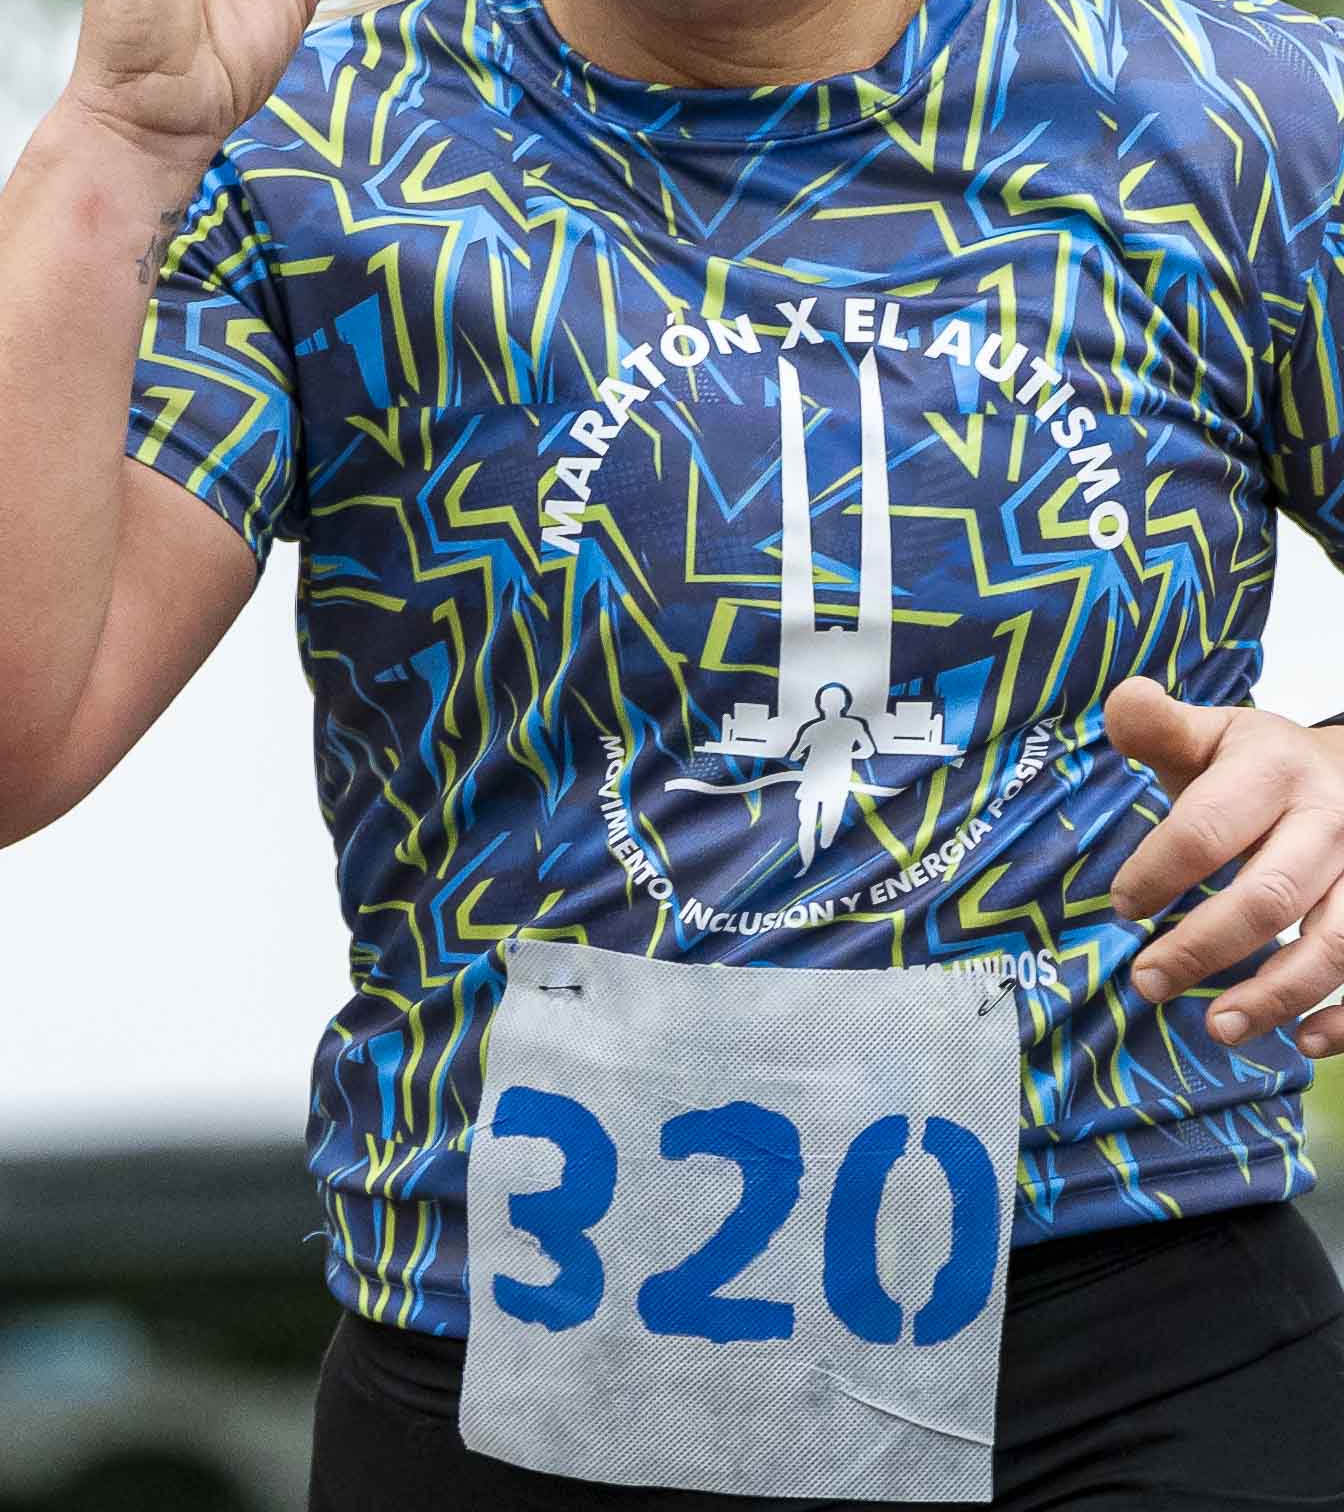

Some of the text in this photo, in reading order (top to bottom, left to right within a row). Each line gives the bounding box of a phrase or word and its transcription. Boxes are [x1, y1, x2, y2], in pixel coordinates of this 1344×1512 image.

[541, 297, 1129, 555] MARATÓN X EL AUTISMO
[839, 892, 862, 912] Y
[869, 818, 993, 905] ENERGÍA
[988, 714, 1063, 819] POSITIVA
[492, 1086, 999, 1347] 320
